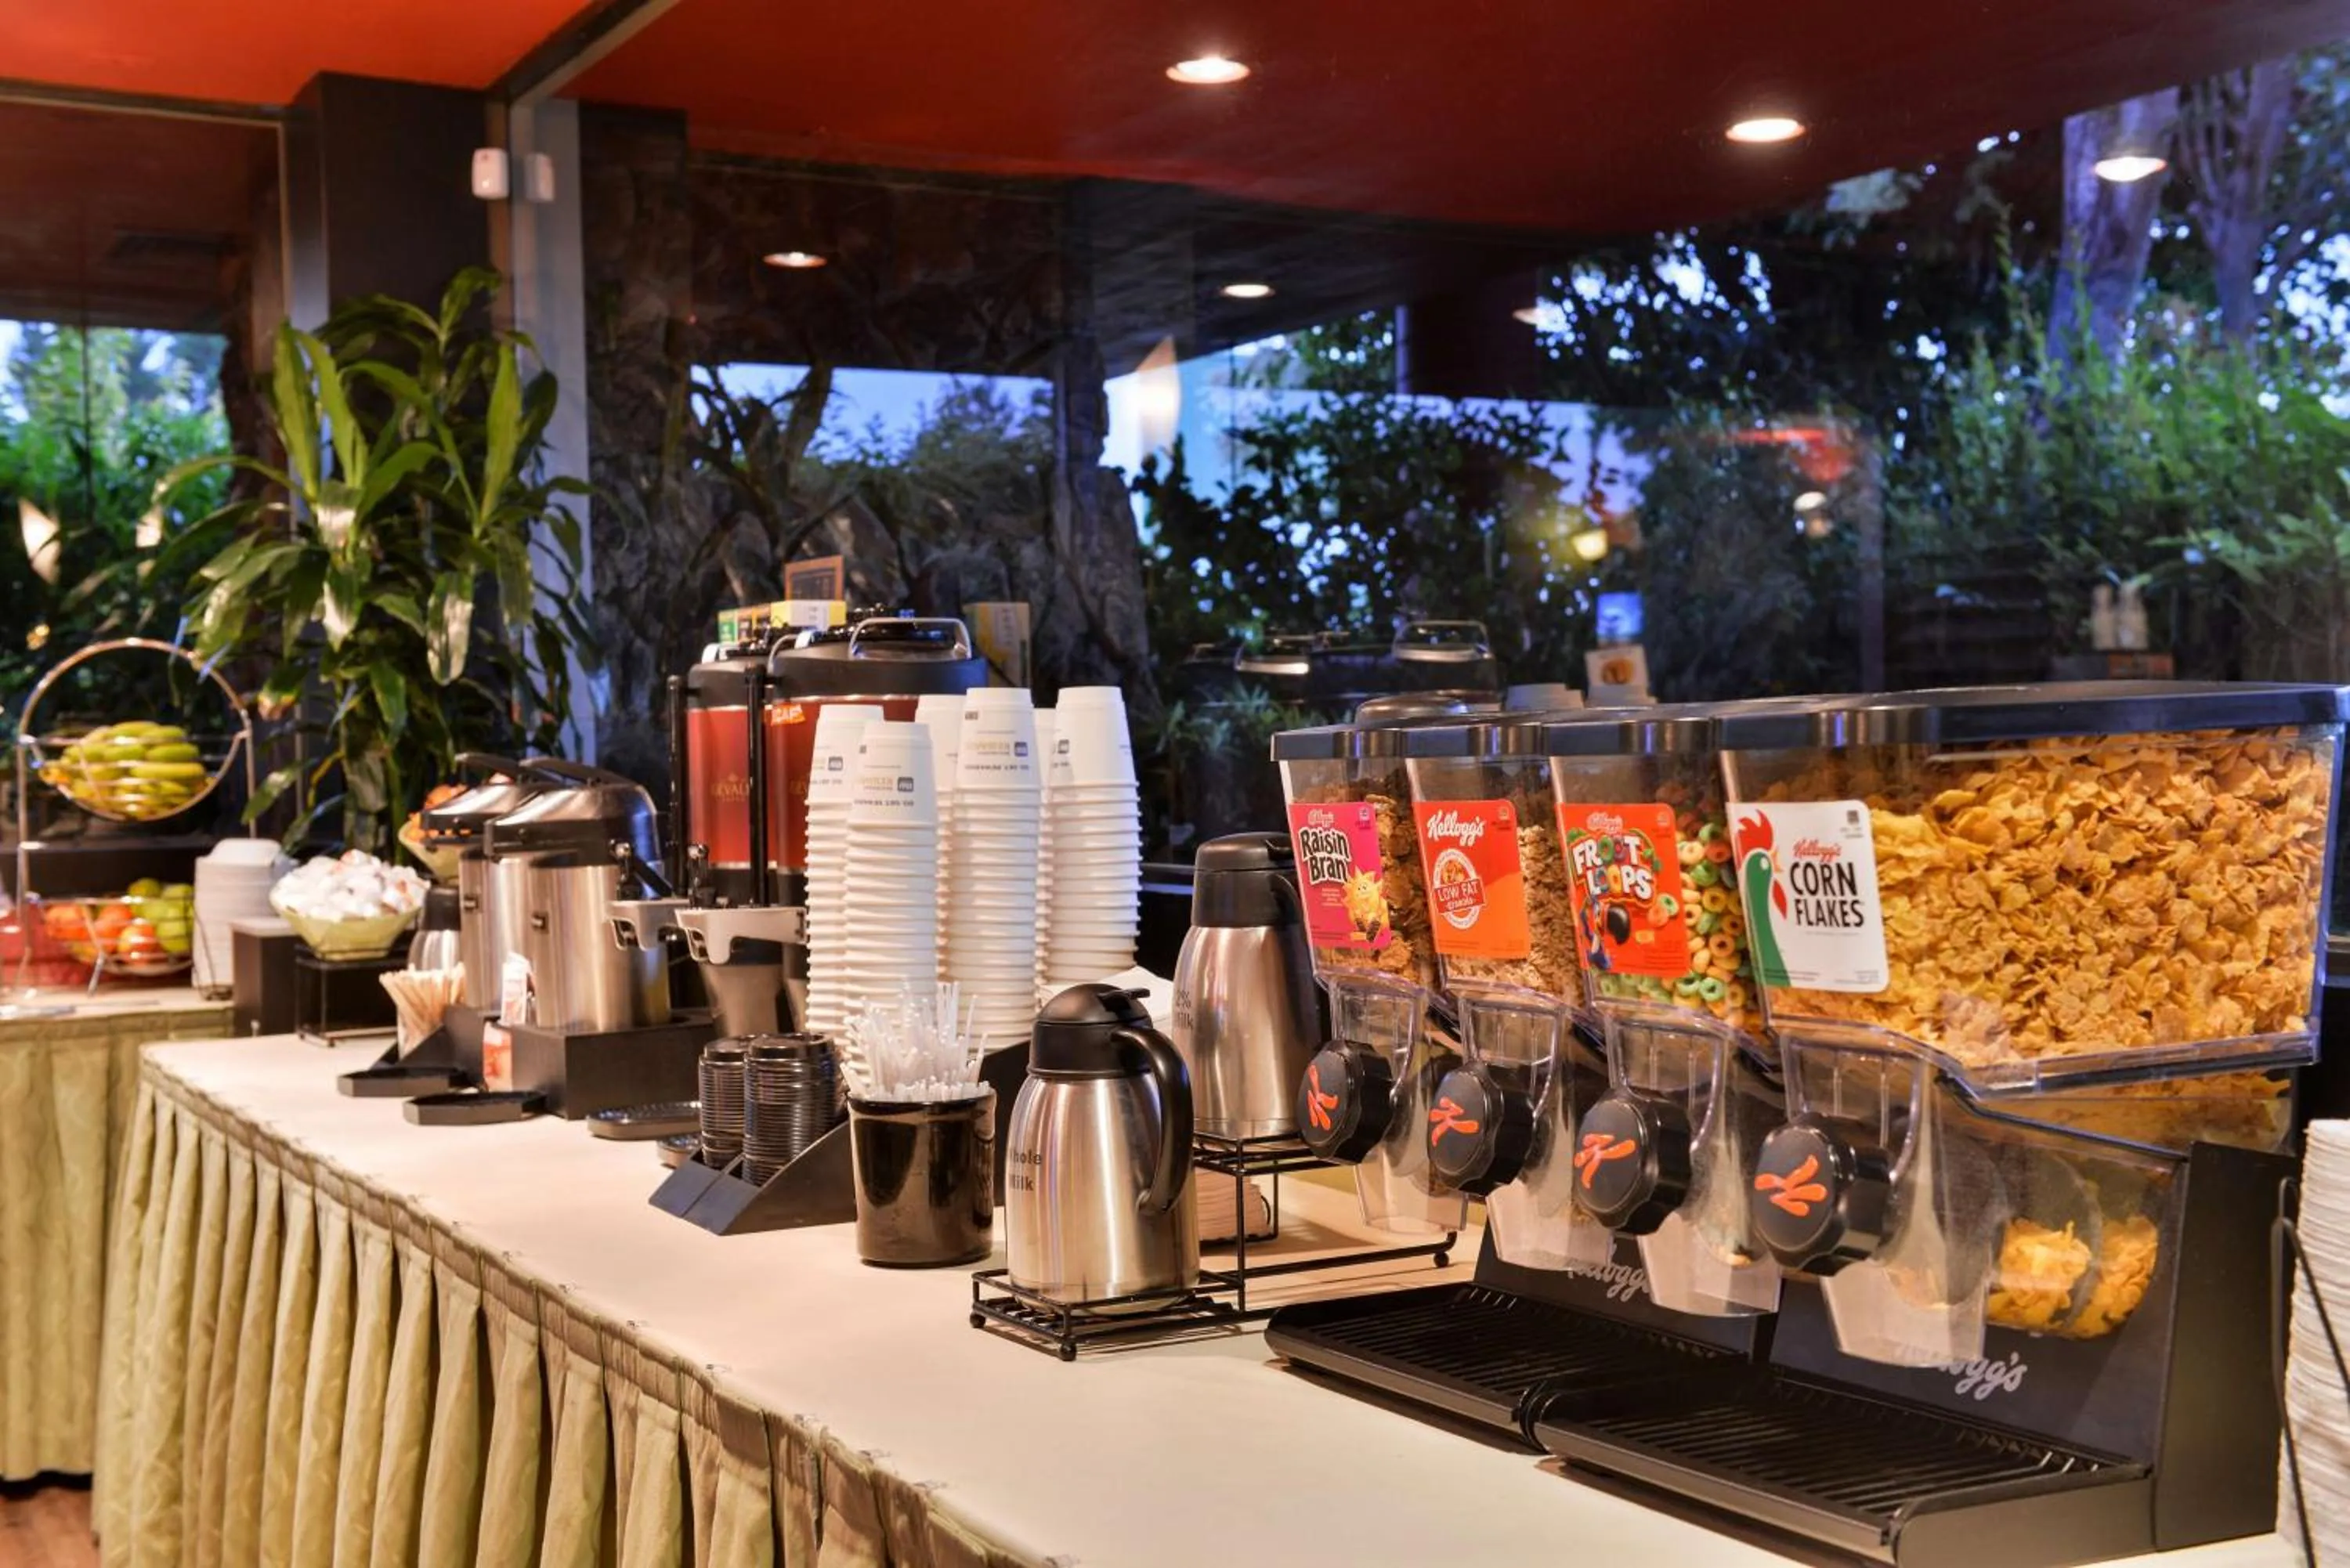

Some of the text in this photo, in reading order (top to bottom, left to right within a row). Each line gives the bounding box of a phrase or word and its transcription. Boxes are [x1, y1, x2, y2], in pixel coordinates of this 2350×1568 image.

[1300, 827, 1350, 861] Raisin
[1426, 809, 1487, 847] Kellogg's
[1307, 855, 1349, 885] Bran
[1573, 835, 1643, 875] FROOT
[1437, 881, 1479, 902] LOW FAT
[1587, 864, 1654, 900] LOOPS
[1790, 862, 1858, 897] CORN
[1795, 899, 1864, 928] FLAKES
